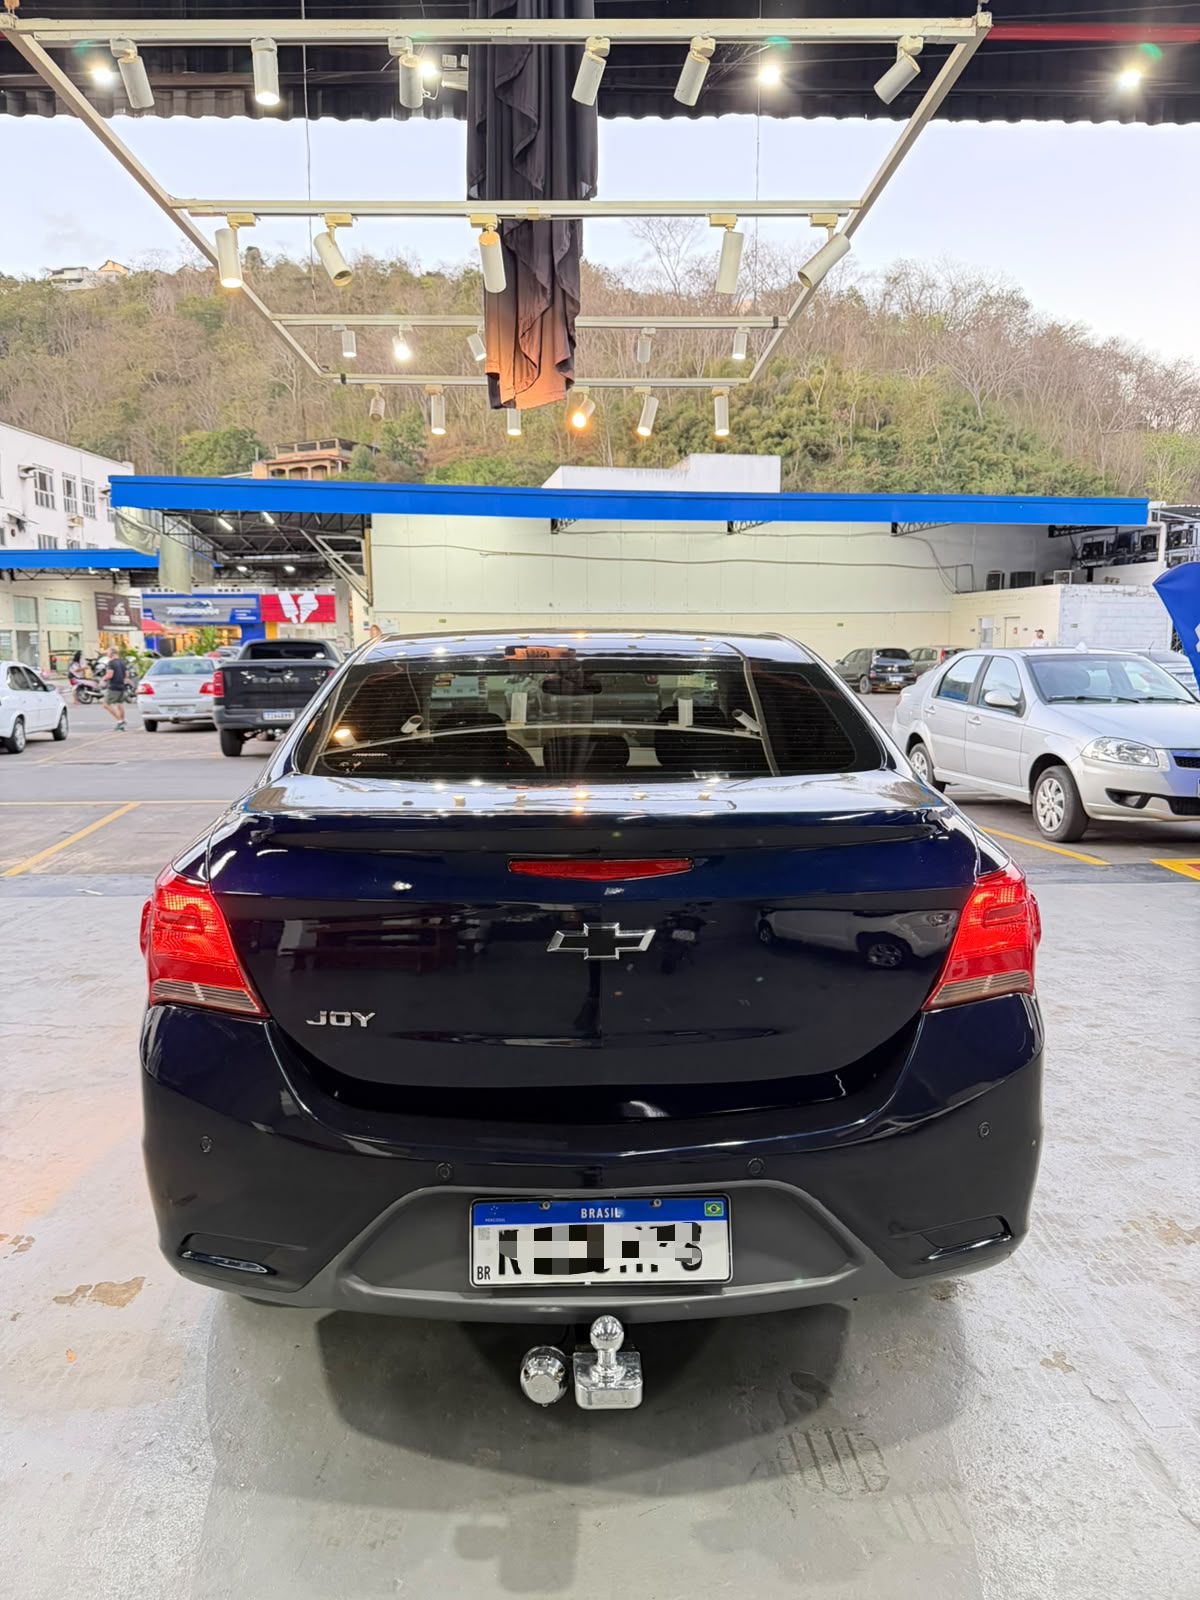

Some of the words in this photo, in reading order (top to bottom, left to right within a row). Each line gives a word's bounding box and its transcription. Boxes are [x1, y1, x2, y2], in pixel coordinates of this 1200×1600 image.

[306, 1010, 376, 1027] JOY
[580, 1207, 621, 1219] BRASIL
[477, 1266, 491, 1280] BR
